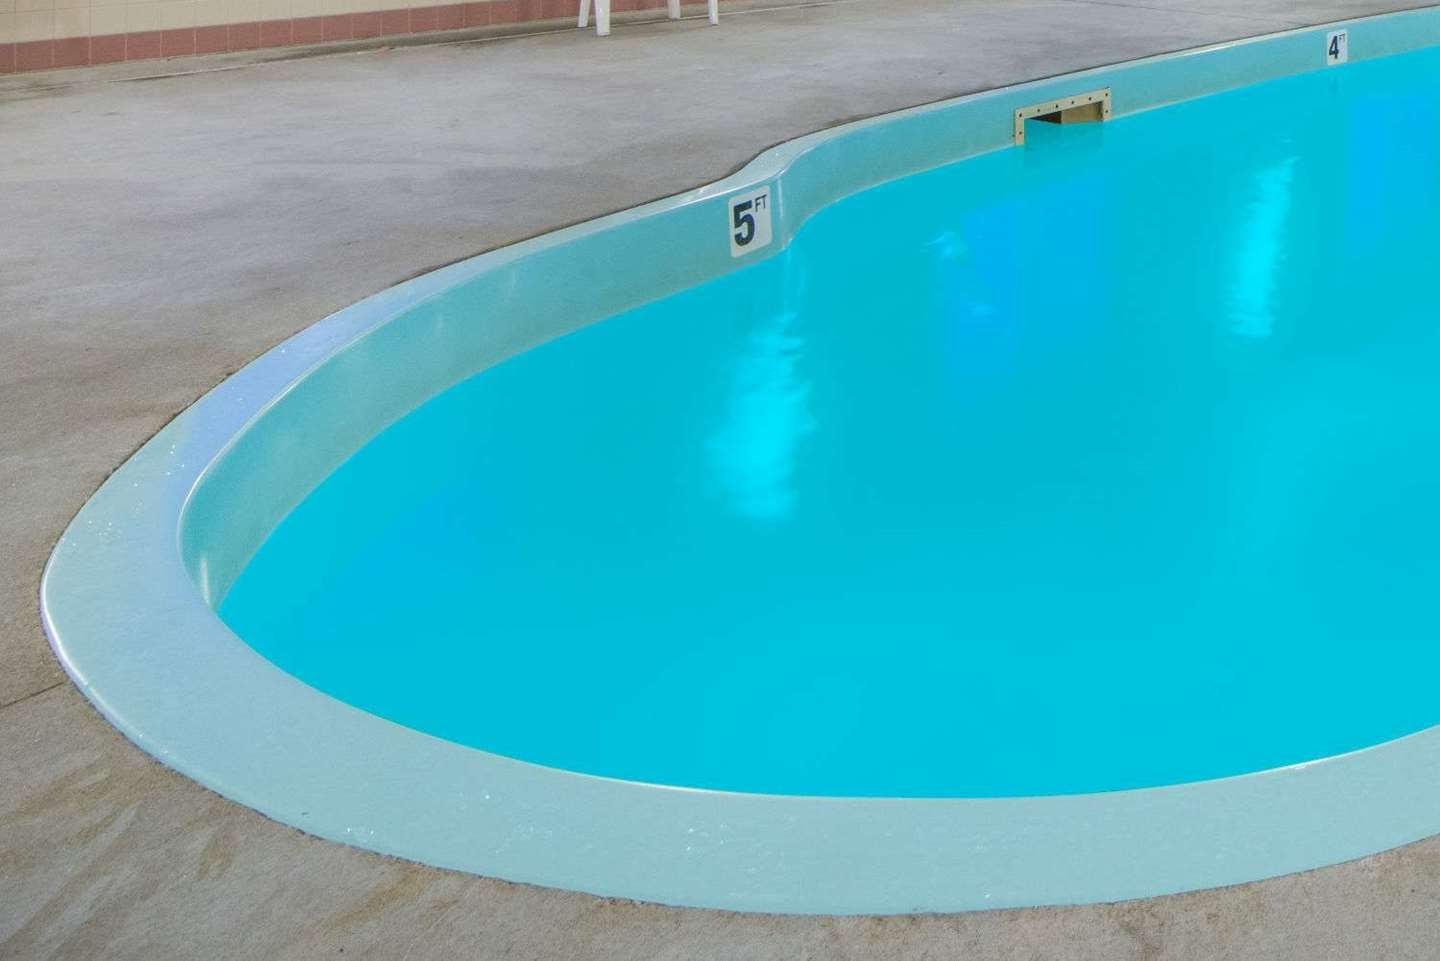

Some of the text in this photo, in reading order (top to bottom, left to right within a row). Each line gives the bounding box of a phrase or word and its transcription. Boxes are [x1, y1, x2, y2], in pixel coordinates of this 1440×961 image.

[1329, 35, 1339, 60] 4
[733, 194, 767, 247] 5 FT
